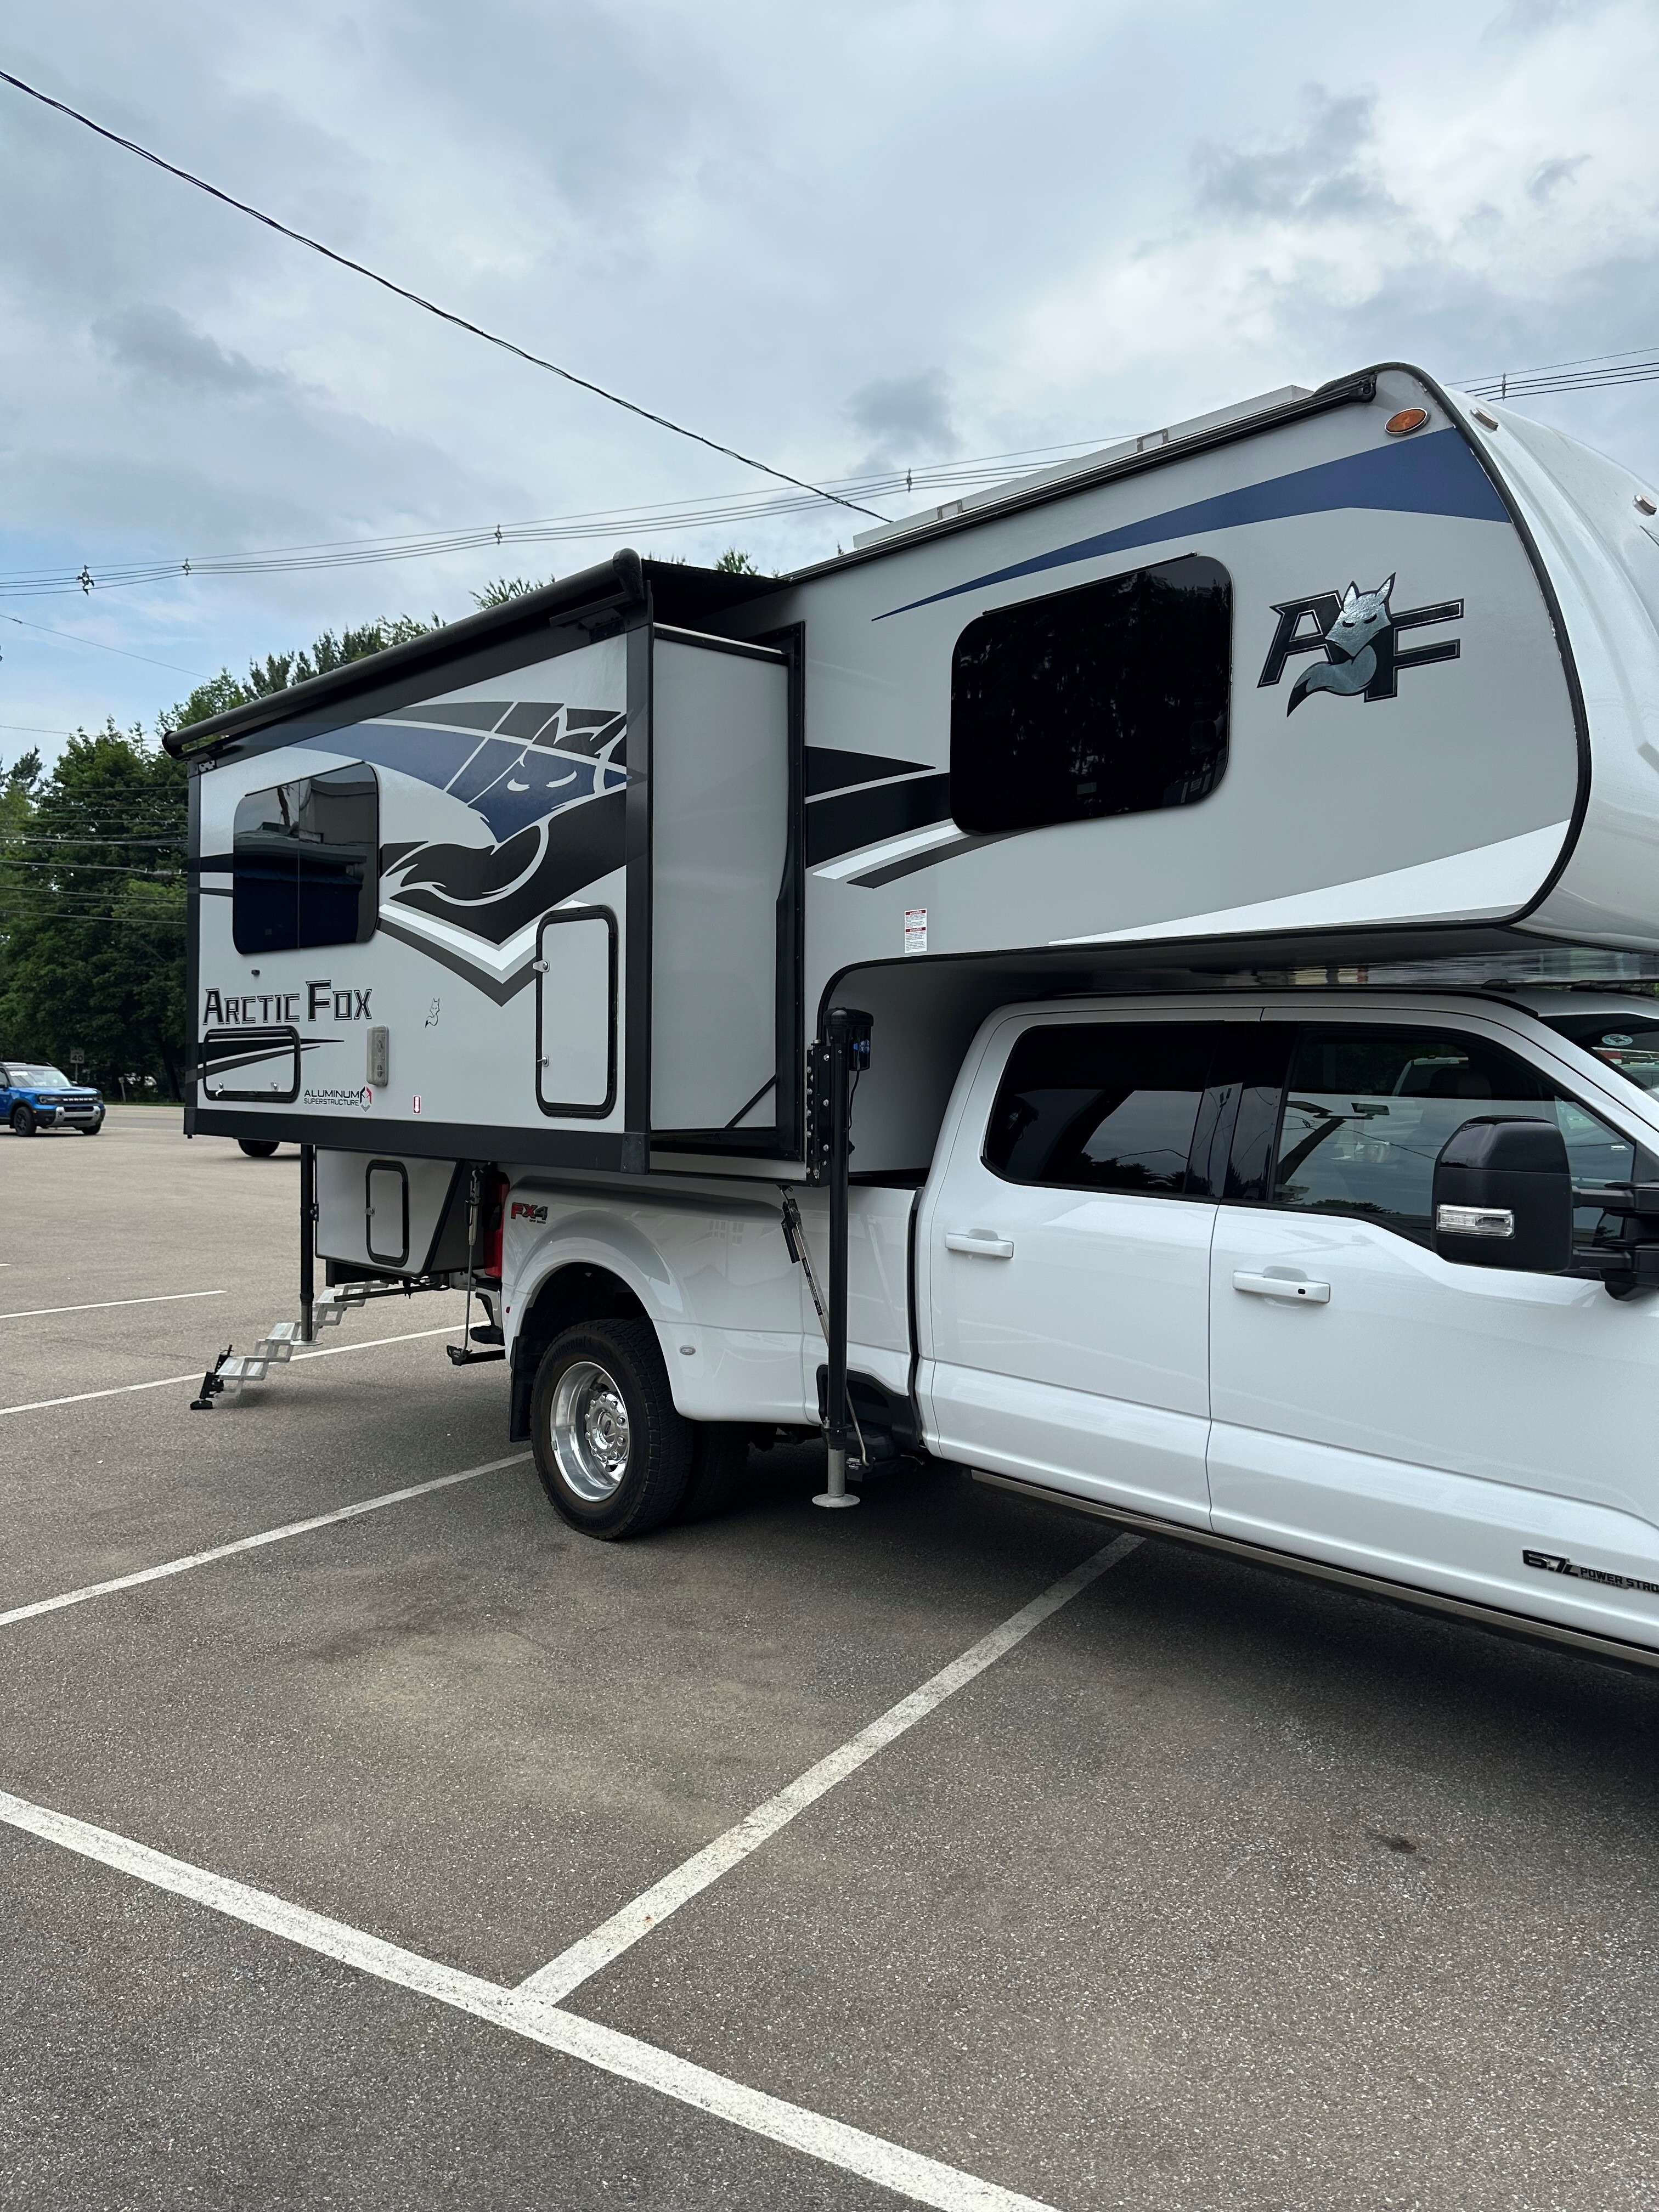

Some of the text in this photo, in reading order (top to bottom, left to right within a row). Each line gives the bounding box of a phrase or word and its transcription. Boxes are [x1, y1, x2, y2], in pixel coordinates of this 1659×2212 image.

[202, 979, 373, 1025] ARCTIC FOX
[304, 1090, 359, 1099] ALUMINUM
[304, 1098, 359, 1106] SUPERSTRUCTURE
[511, 1202, 548, 1221] FX4
[1522, 1549, 1579, 1577] 6.7L
[1580, 1567, 1623, 1584] POWER
